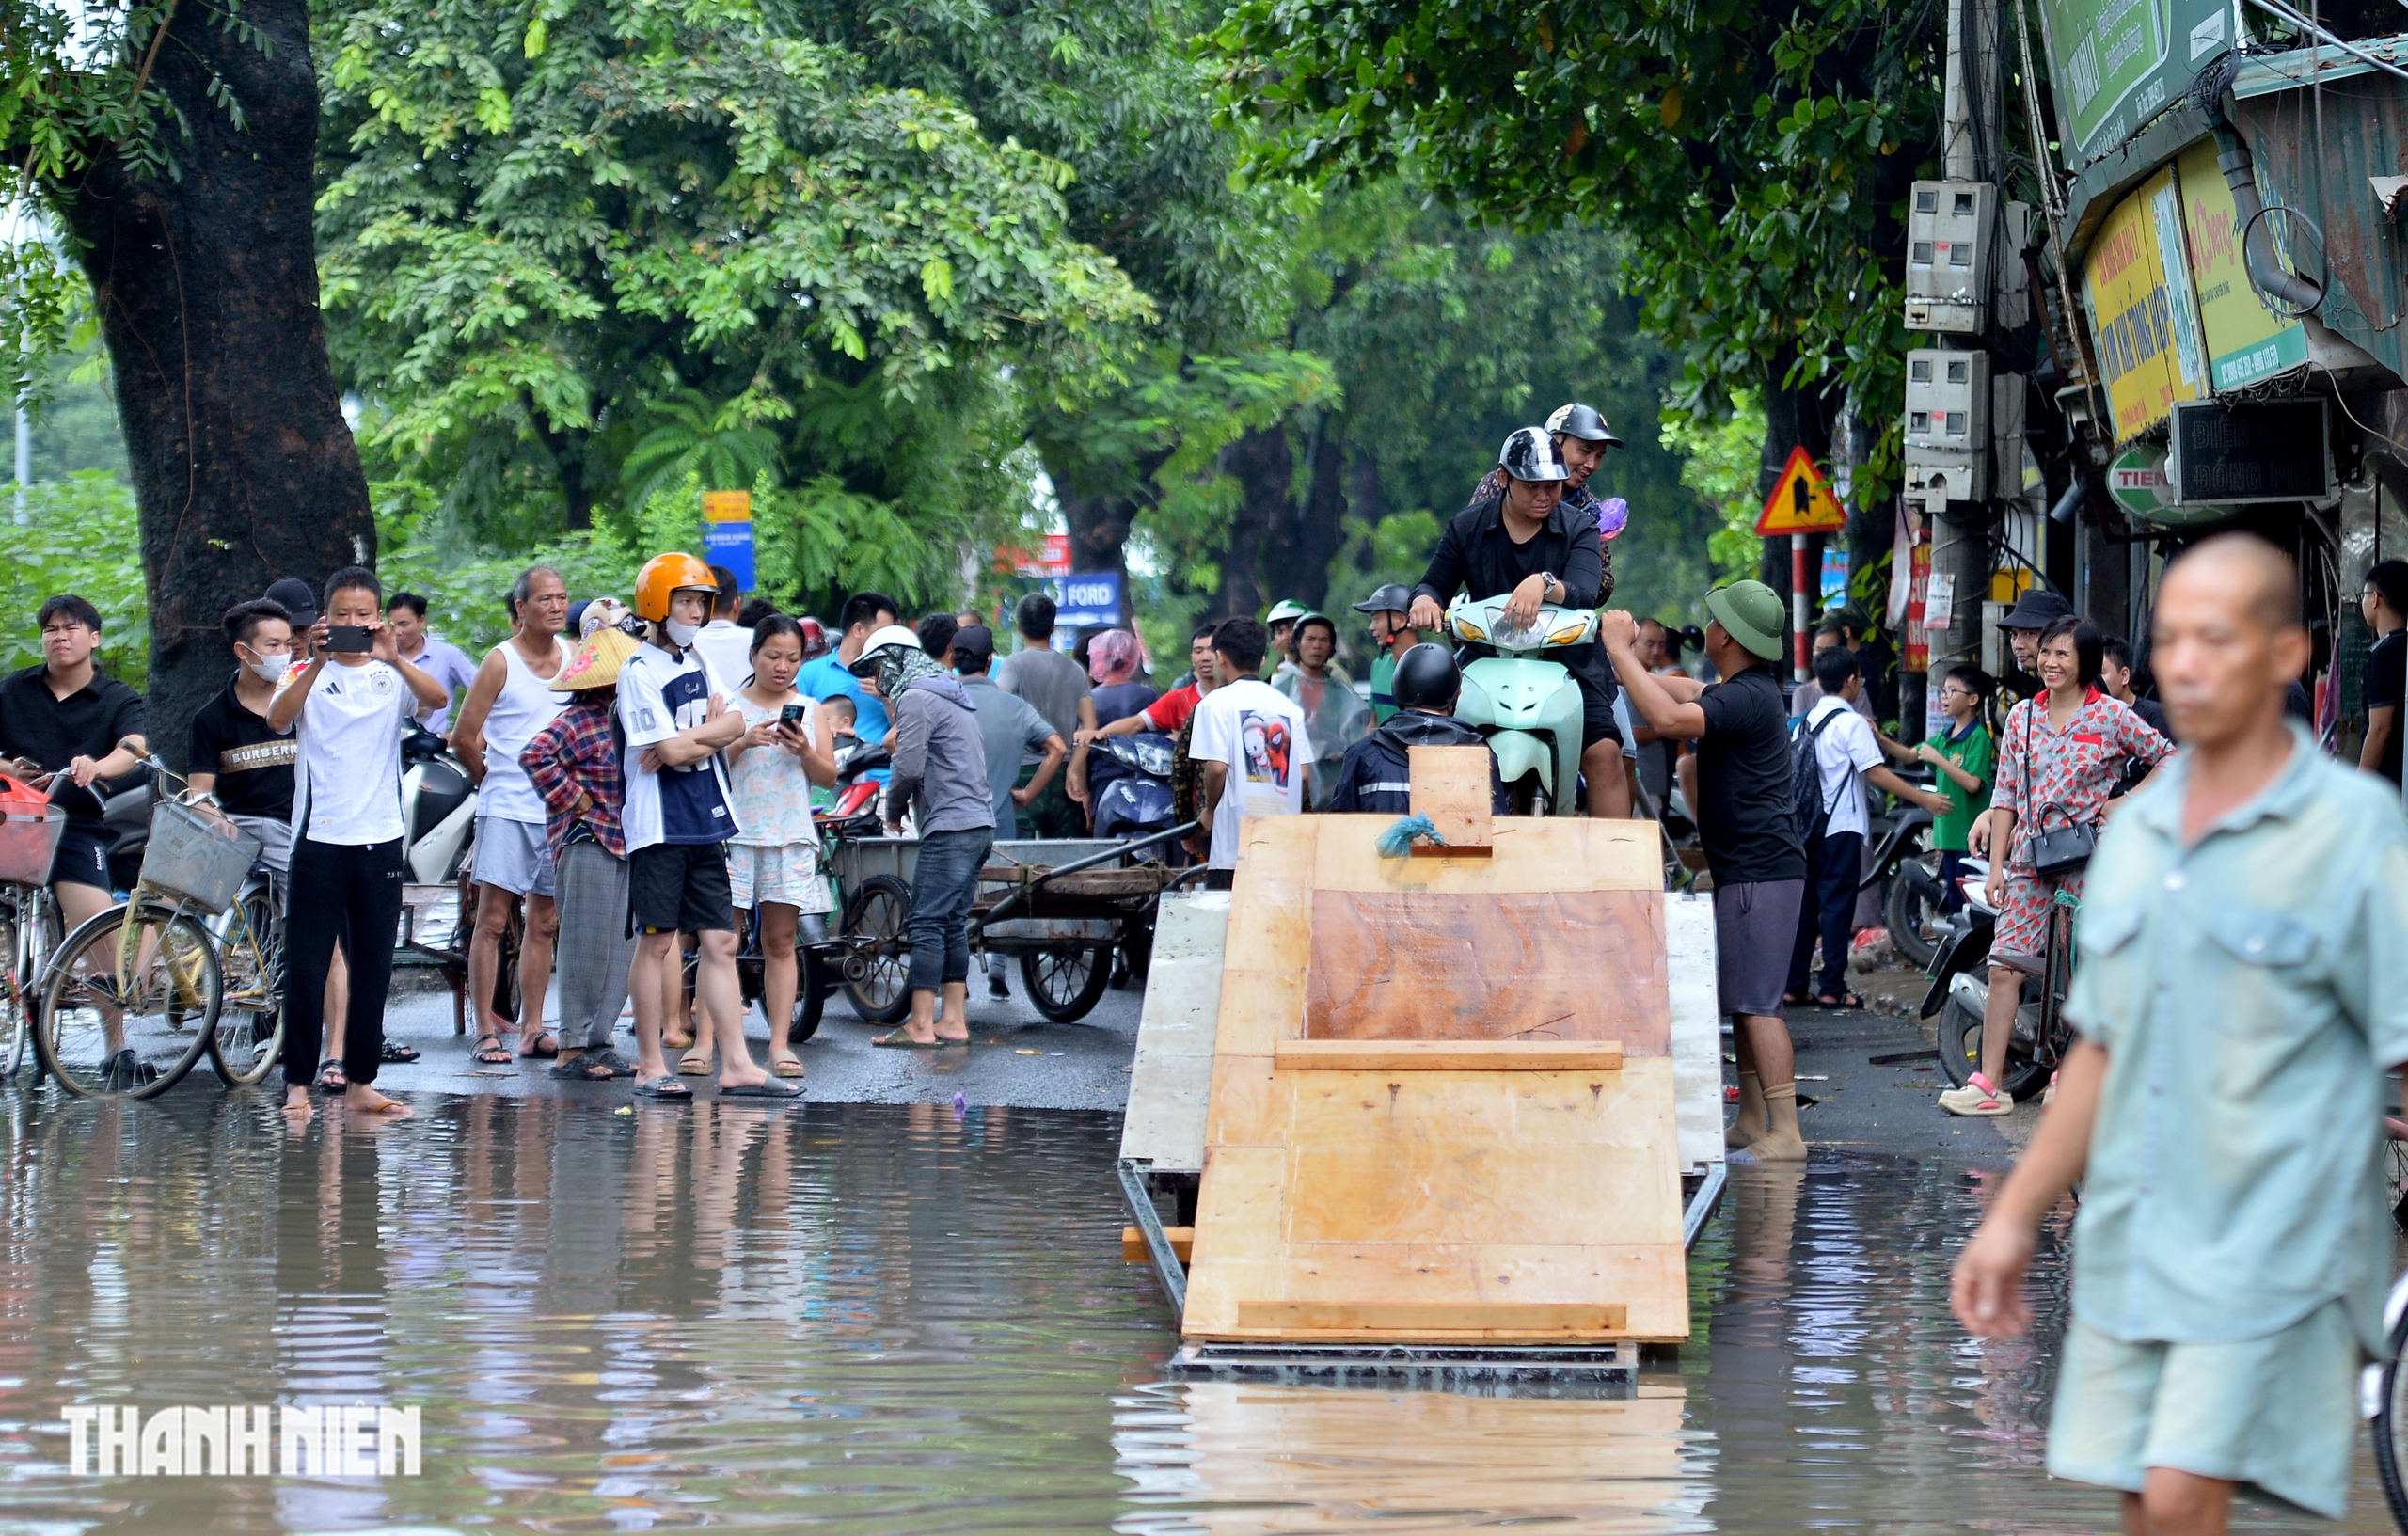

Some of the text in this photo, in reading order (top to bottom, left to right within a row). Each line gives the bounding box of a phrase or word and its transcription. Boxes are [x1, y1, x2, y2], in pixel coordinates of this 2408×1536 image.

[2188, 198, 2235, 281] gCheng
[2114, 300, 2135, 373] KHÍ
[2127, 280, 2155, 366] TỔNG
[2147, 282, 2171, 363] HỢP
[2192, 412, 2249, 453] ĐIỆN
[1067, 583, 1115, 607] FORD
[628, 707, 656, 734] 10
[232, 744, 298, 763] BURBERR
